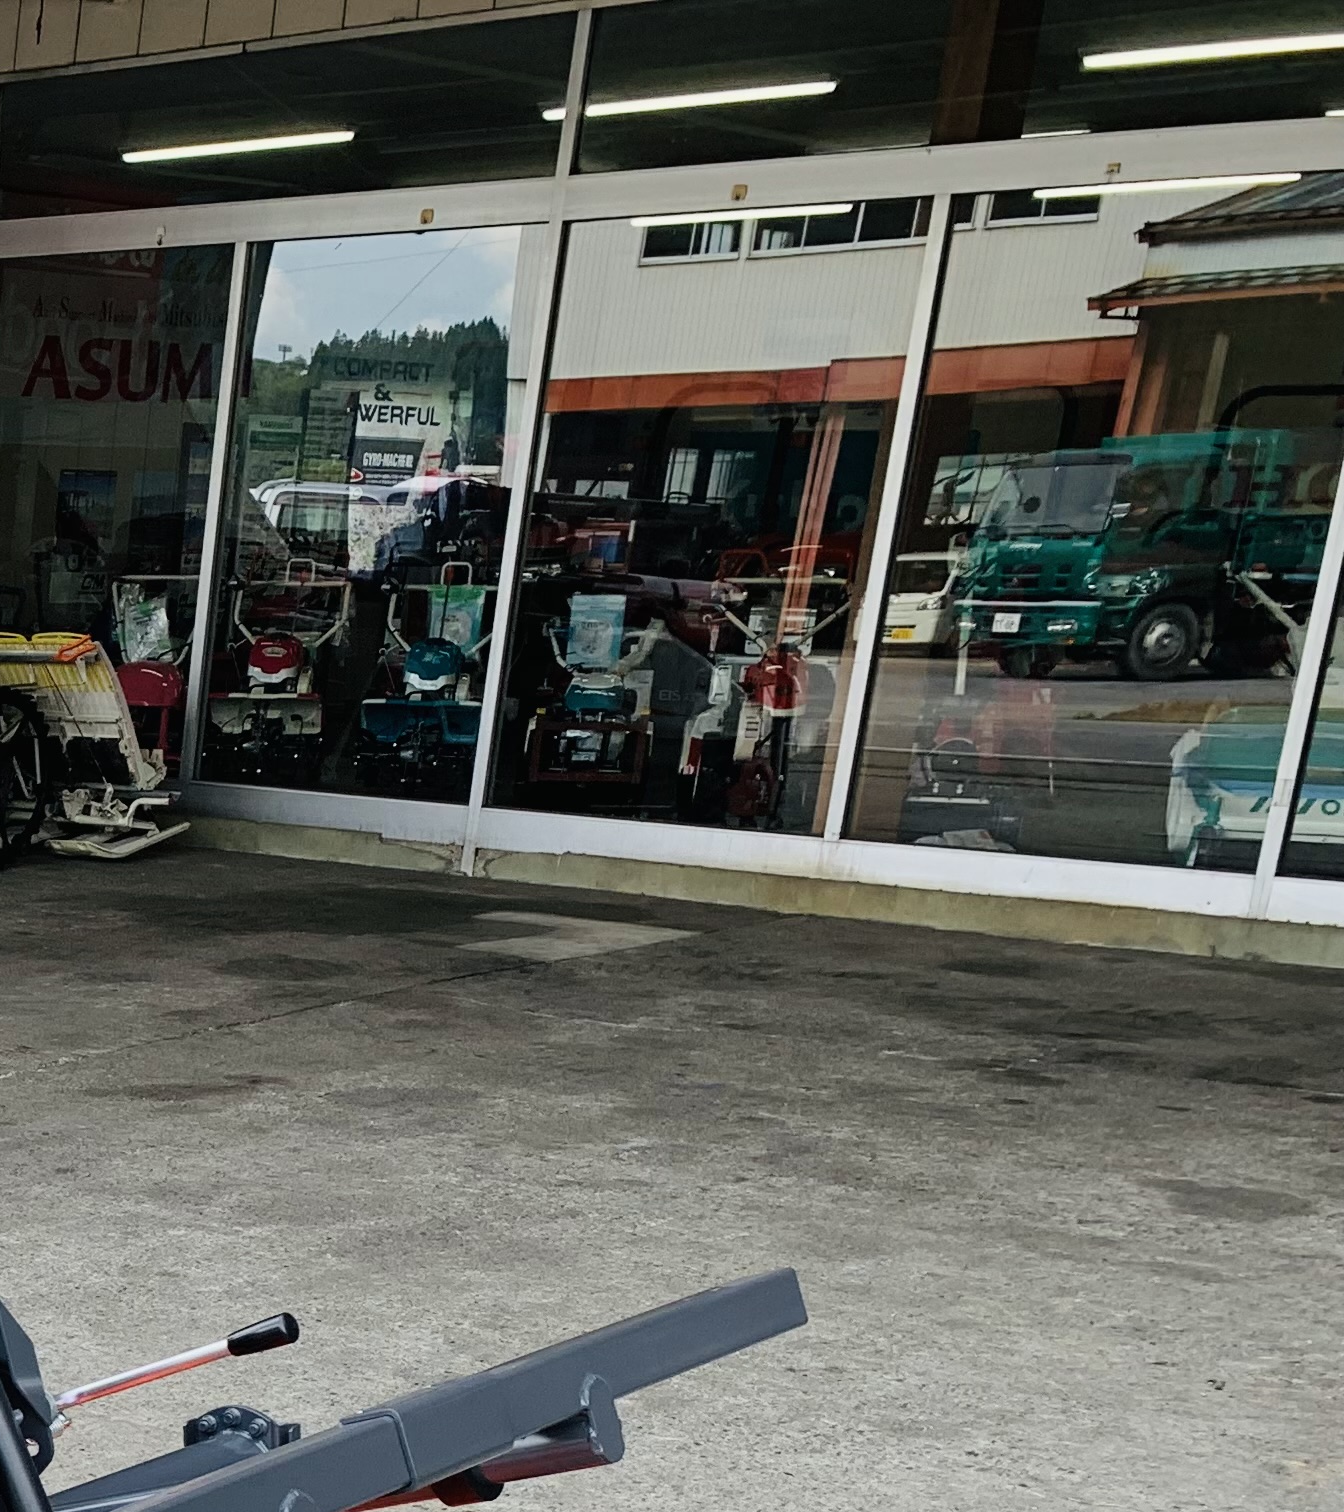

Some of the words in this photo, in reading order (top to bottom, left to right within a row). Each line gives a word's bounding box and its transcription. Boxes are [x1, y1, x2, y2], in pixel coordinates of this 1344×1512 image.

[21, 335, 251, 403] ASUM
[334, 356, 434, 382] COMPACT
[374, 383, 393, 401] &
[358, 402, 441, 427] WERFUL
